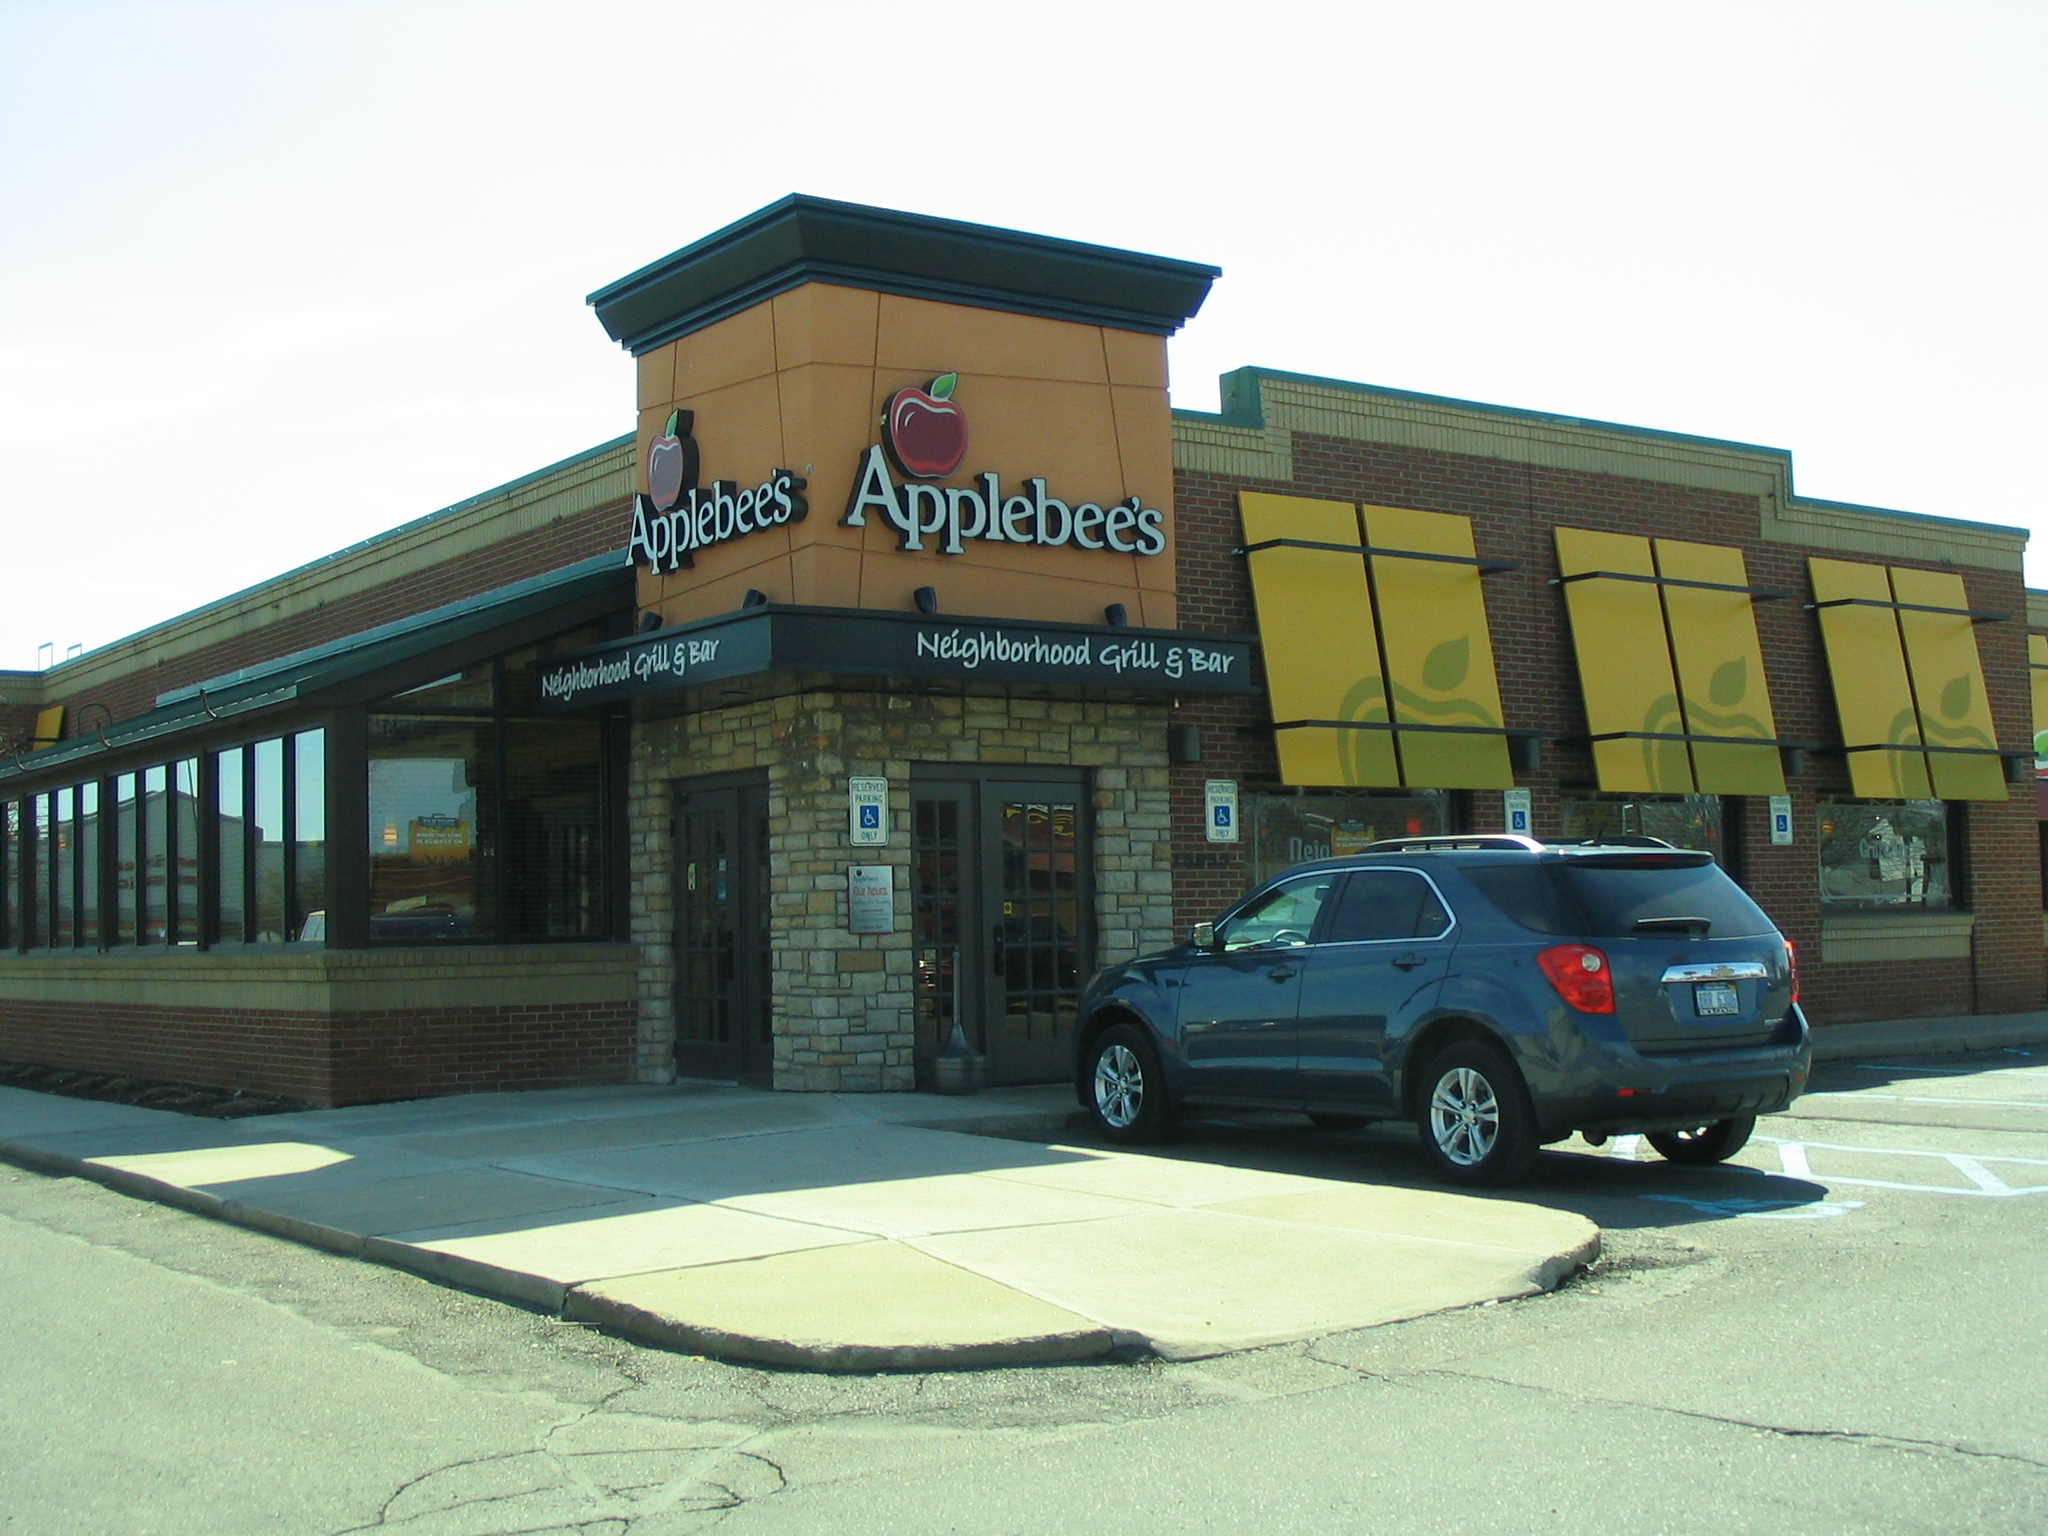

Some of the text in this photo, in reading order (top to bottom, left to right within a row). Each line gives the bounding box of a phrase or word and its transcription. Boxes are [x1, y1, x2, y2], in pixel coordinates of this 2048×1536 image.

[625, 468, 792, 576] Applebee's
[846, 443, 1167, 556] Applebee's
[542, 639, 720, 701] Neighborhood Grill & Bar
[917, 628, 1235, 678] Neighborhood Grill & Bar
